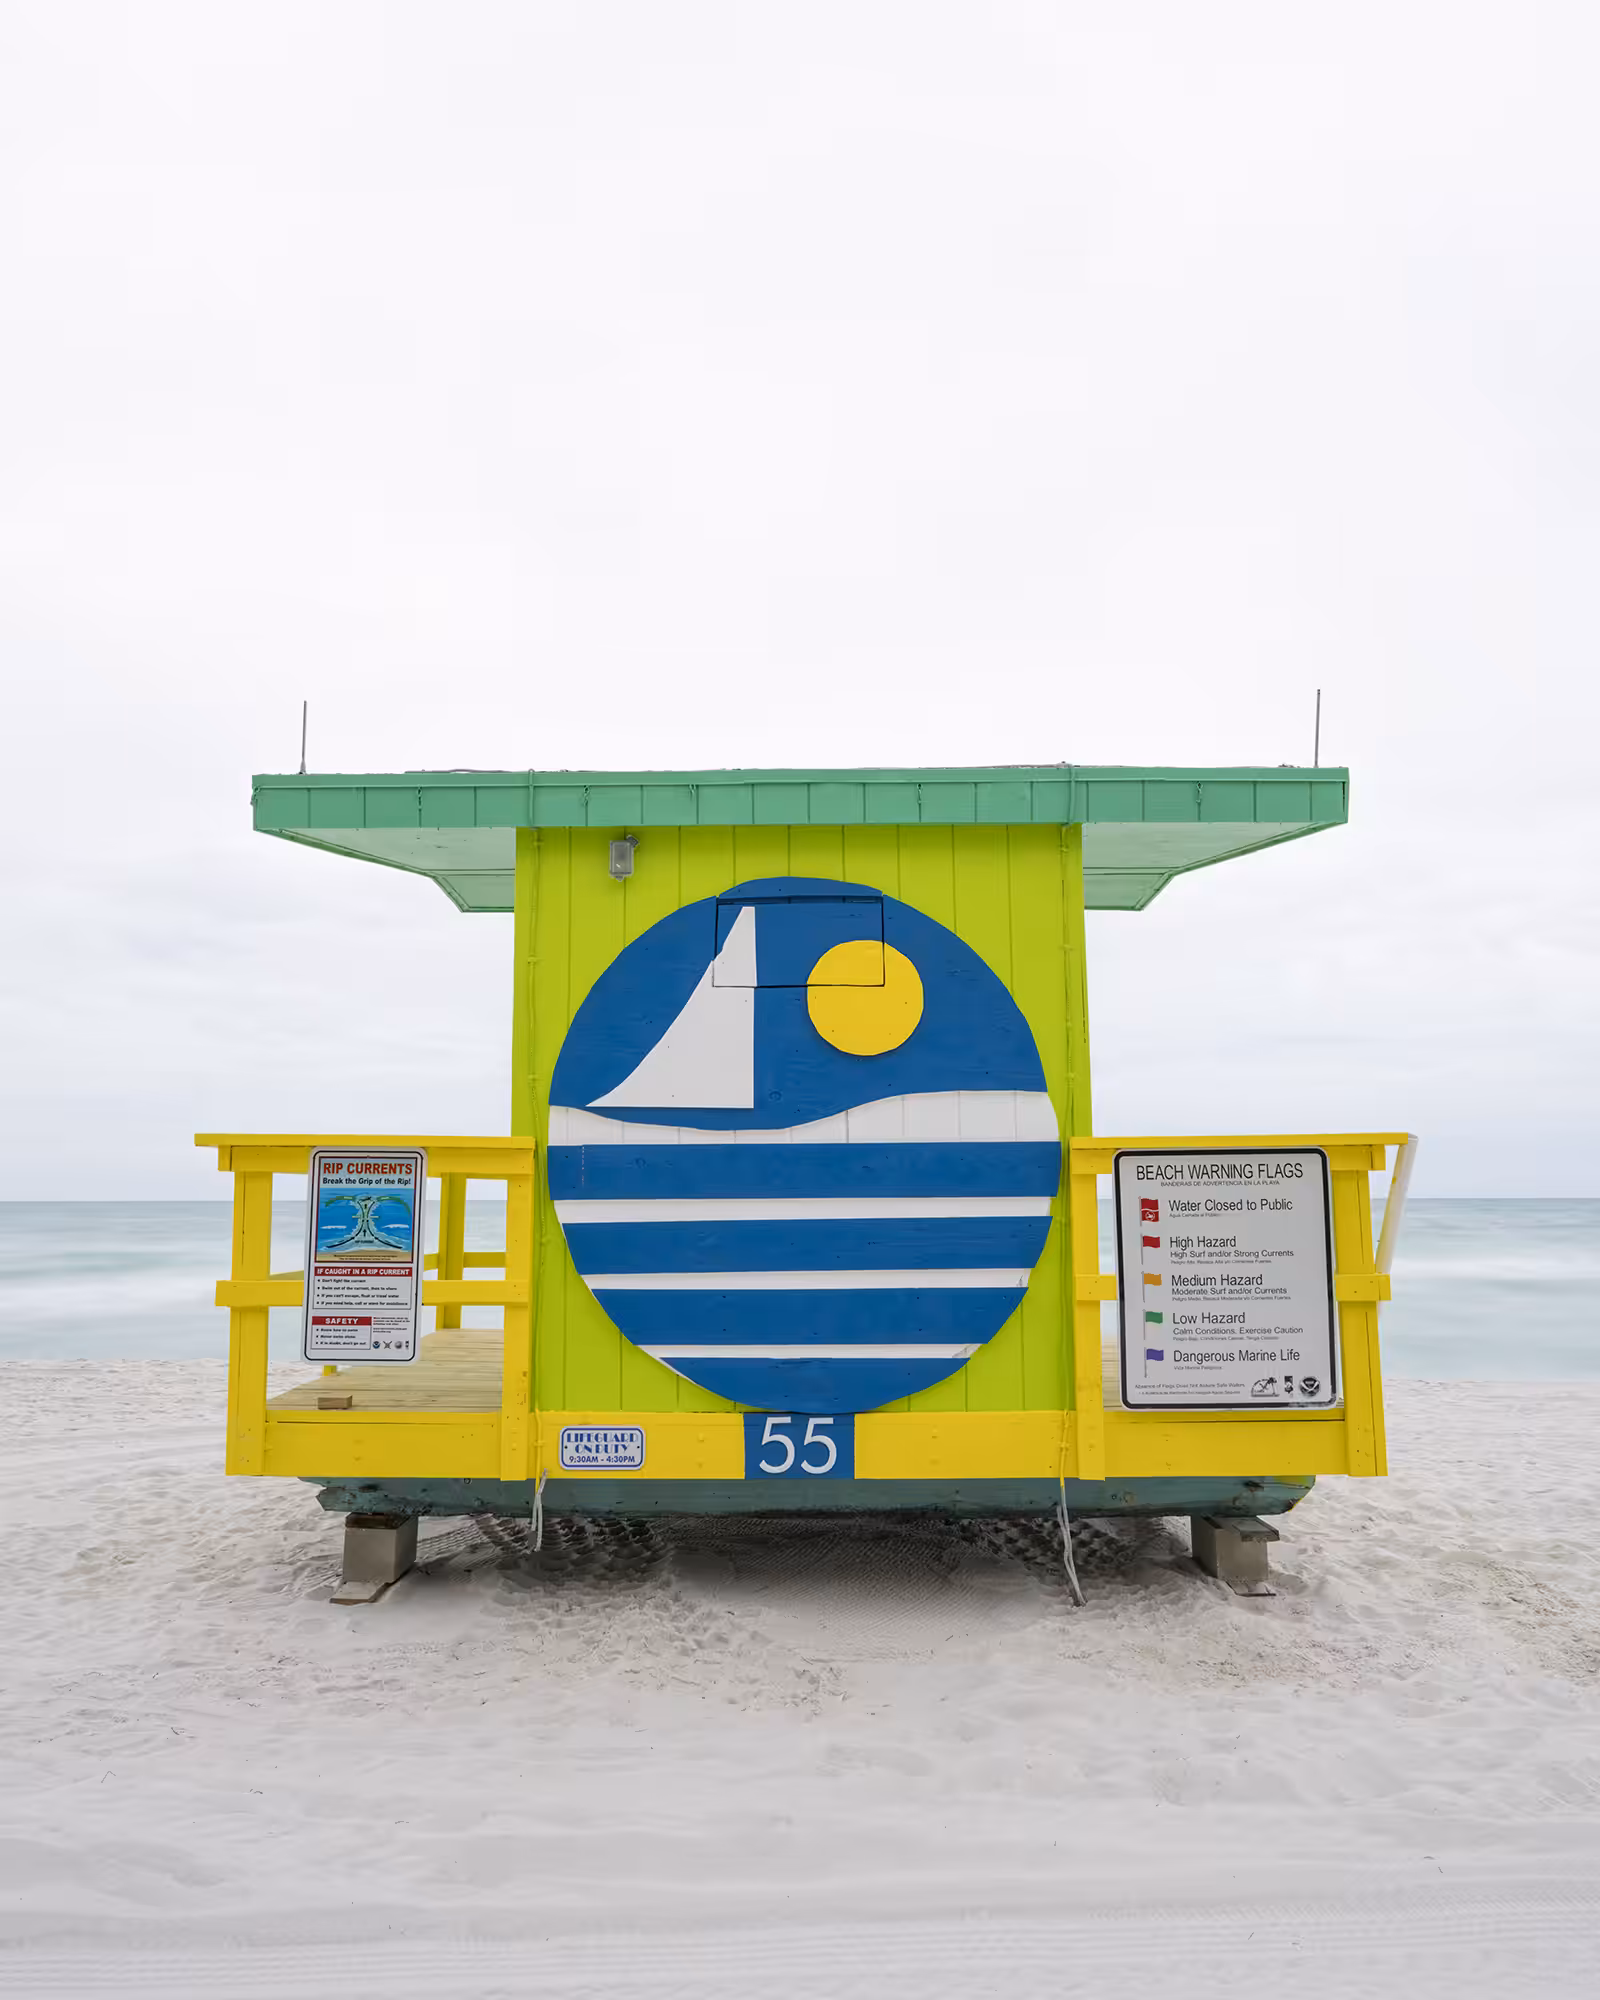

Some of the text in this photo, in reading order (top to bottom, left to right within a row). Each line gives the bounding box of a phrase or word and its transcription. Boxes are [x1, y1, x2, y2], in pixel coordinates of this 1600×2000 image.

[323, 1163, 413, 1174] RIP CURRENTS
[1136, 1163, 1303, 1180] BEACH WARNING FLAGS
[322, 1177, 343, 1185] Break
[345, 1177, 357, 1185] the
[358, 1177, 373, 1186] Grip
[397, 1178, 411, 1186] Rip!
[1168, 1198, 1293, 1212] Water Closed to Public
[1169, 1235, 1237, 1251] High Hazard
[1170, 1249, 1295, 1259] High Surf and/or Strong Currents
[1171, 1273, 1263, 1287] Medium Hazard
[1210, 1287, 1227, 1295] Surf
[1227, 1286, 1253, 1295] and/or
[1254, 1286, 1288, 1294] Currents
[1172, 1312, 1246, 1325] Low Hazard
[1172, 1327, 1193, 1335] Calm
[1239, 1326, 1272, 1334] Exercise
[1273, 1326, 1304, 1334] Caution
[1173, 1348, 1301, 1365] Dangerous Marine Life
[566, 1432, 639, 1443] LIFEGUARD
[574, 1443, 630, 1454] ON DUTY
[759, 1416, 837, 1474] 55
[569, 1455, 599, 1463] 9:30AM
[606, 1455, 635, 1463] 4:30PM
